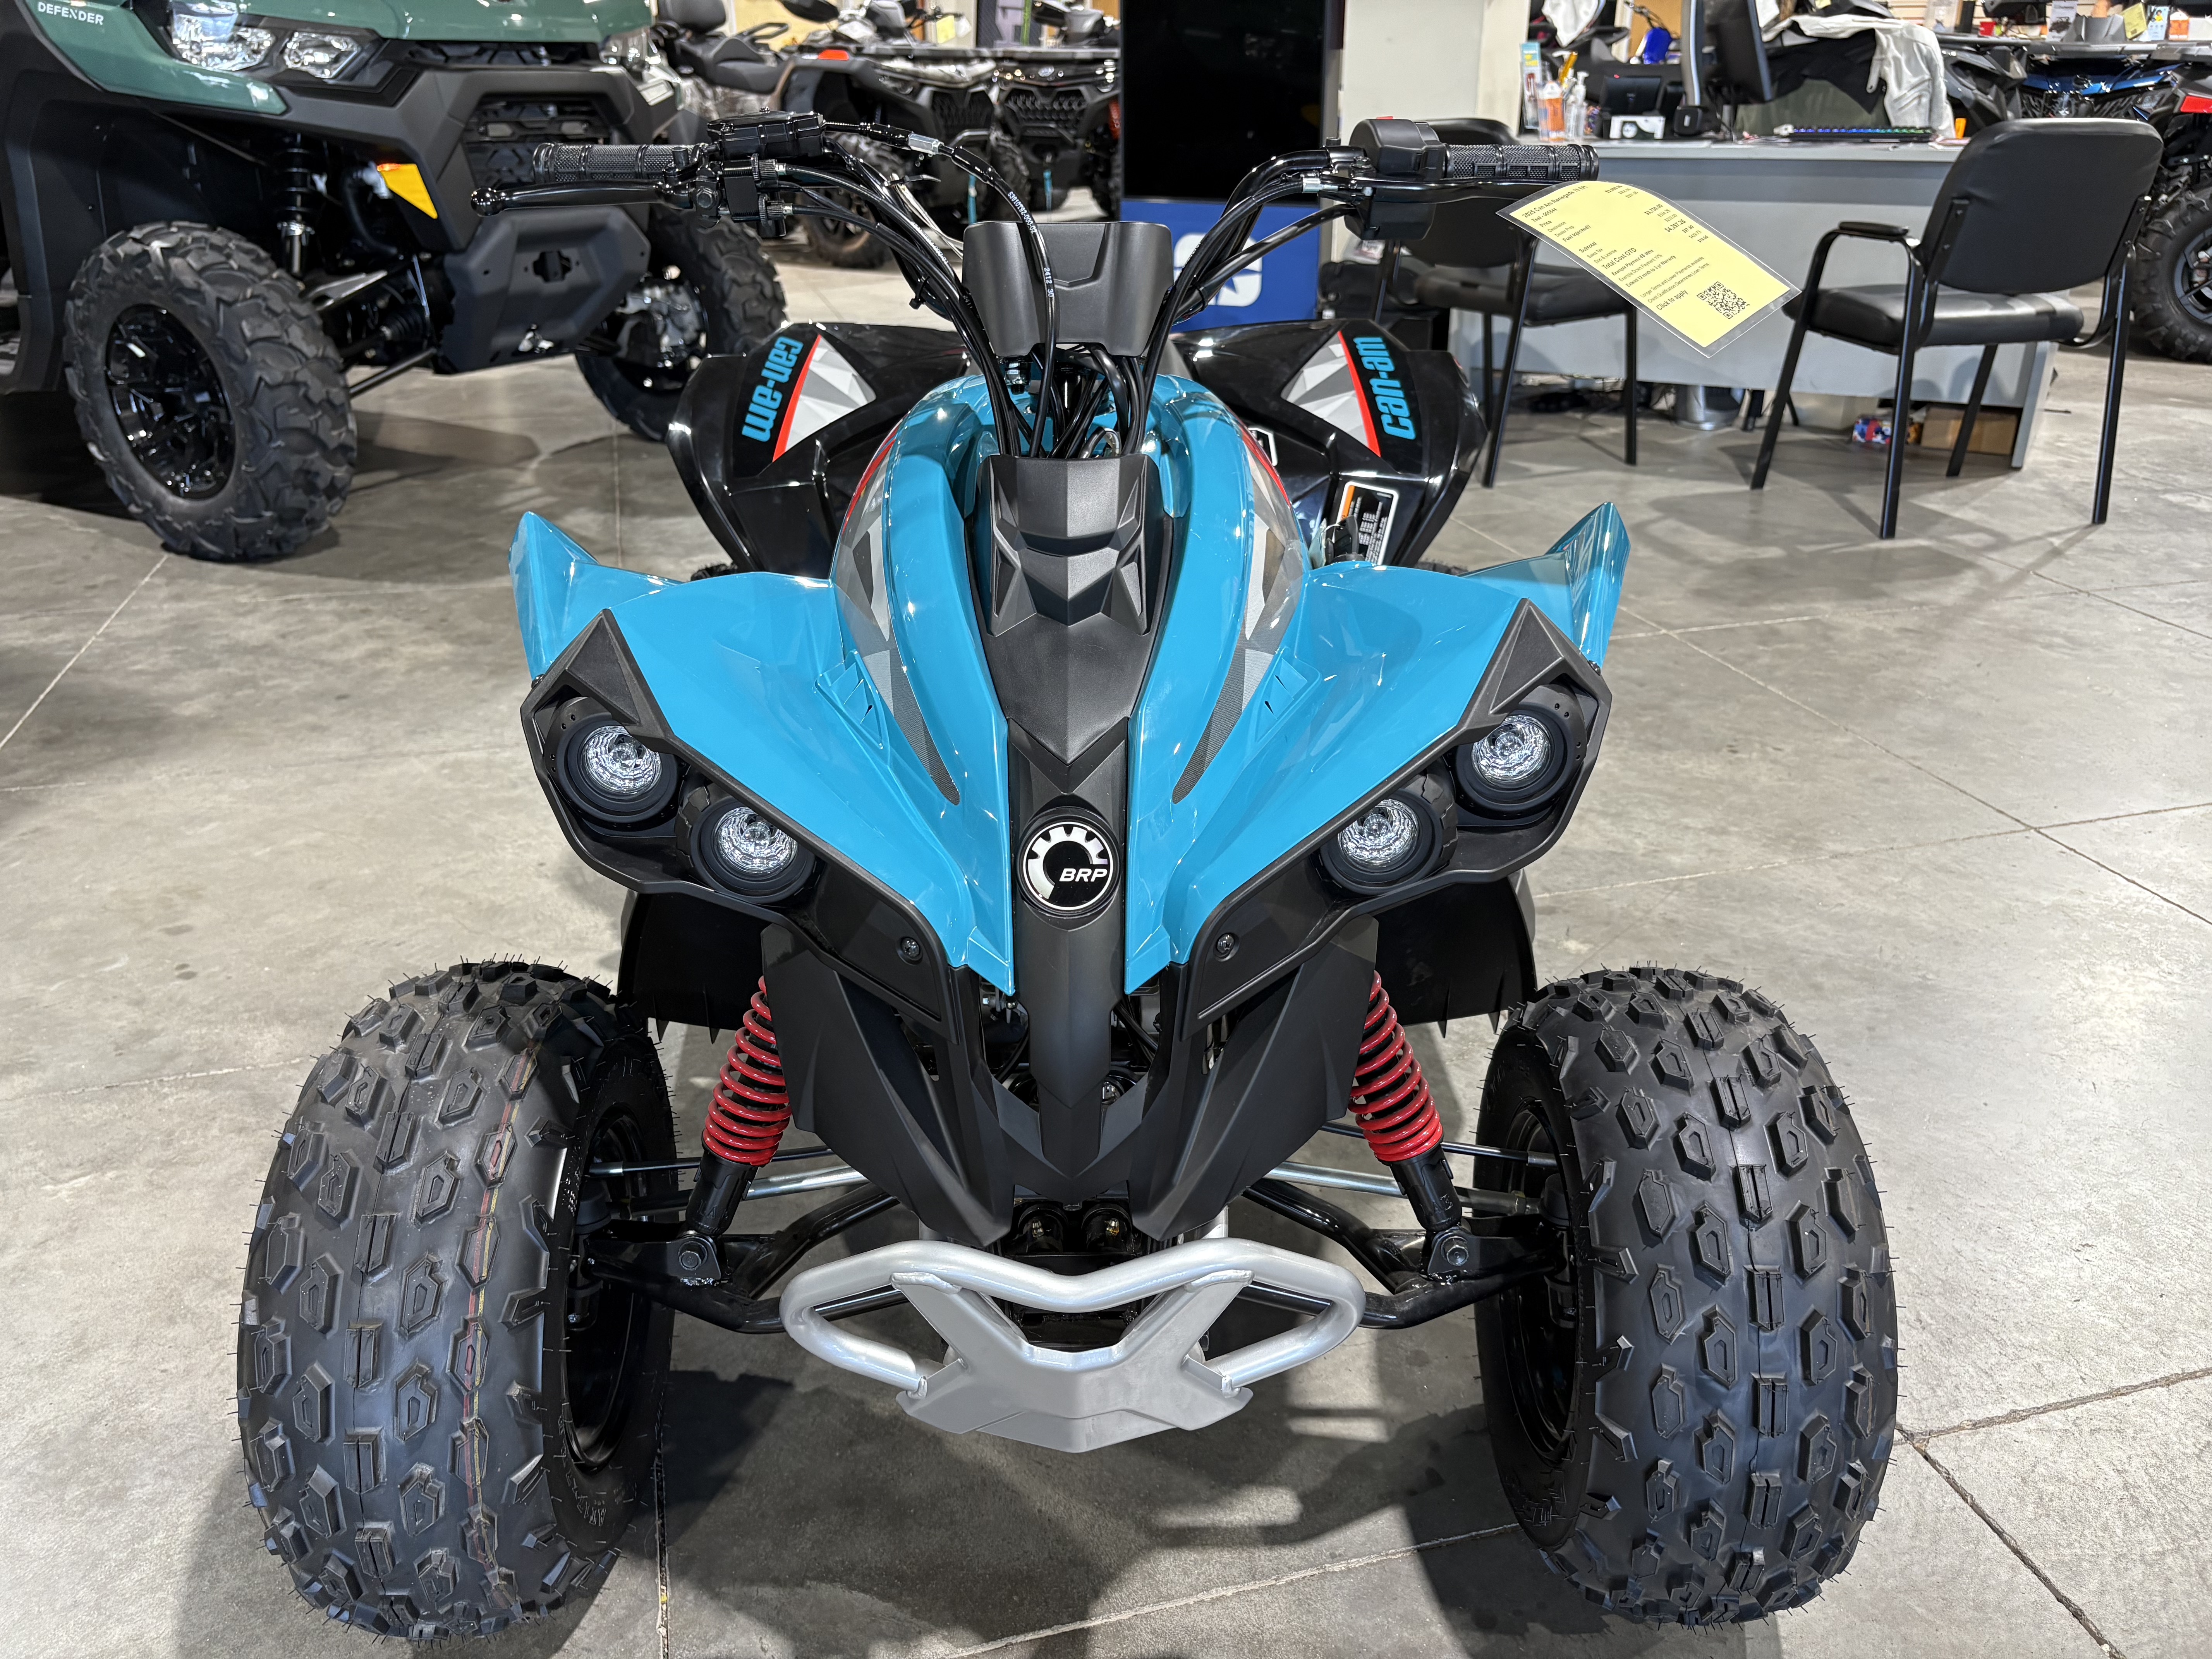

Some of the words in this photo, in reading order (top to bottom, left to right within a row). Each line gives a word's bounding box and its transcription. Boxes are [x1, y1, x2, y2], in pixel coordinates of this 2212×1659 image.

[37, 2, 105, 25] DEFENDER
[1522, 210, 1536, 218] 2025
[1551, 191, 1575, 203] Renegade
[1664, 219, 1686, 232] $4,297.26
[1601, 260, 1616, 270] Total
[1613, 254, 1627, 262] Cost
[1624, 247, 1637, 256] OTD
[1611, 266, 1627, 276] Example
[1625, 257, 1641, 267] Payment
[1618, 272, 1634, 282] Example
[1640, 258, 1656, 268] Payment
[1660, 255, 1676, 265] Warranty
[1640, 289, 1652, 298] Longer
[1666, 273, 1677, 282] Lower
[1675, 264, 1692, 275] Payments
[1647, 295, 1659, 303] Credit
[1657, 285, 1676, 297] Qualification
[1674, 273, 1693, 286] Determines
[1656, 301, 1671, 310] Click
[1674, 289, 1688, 299] apply
[1059, 868, 1108, 882] BRP
